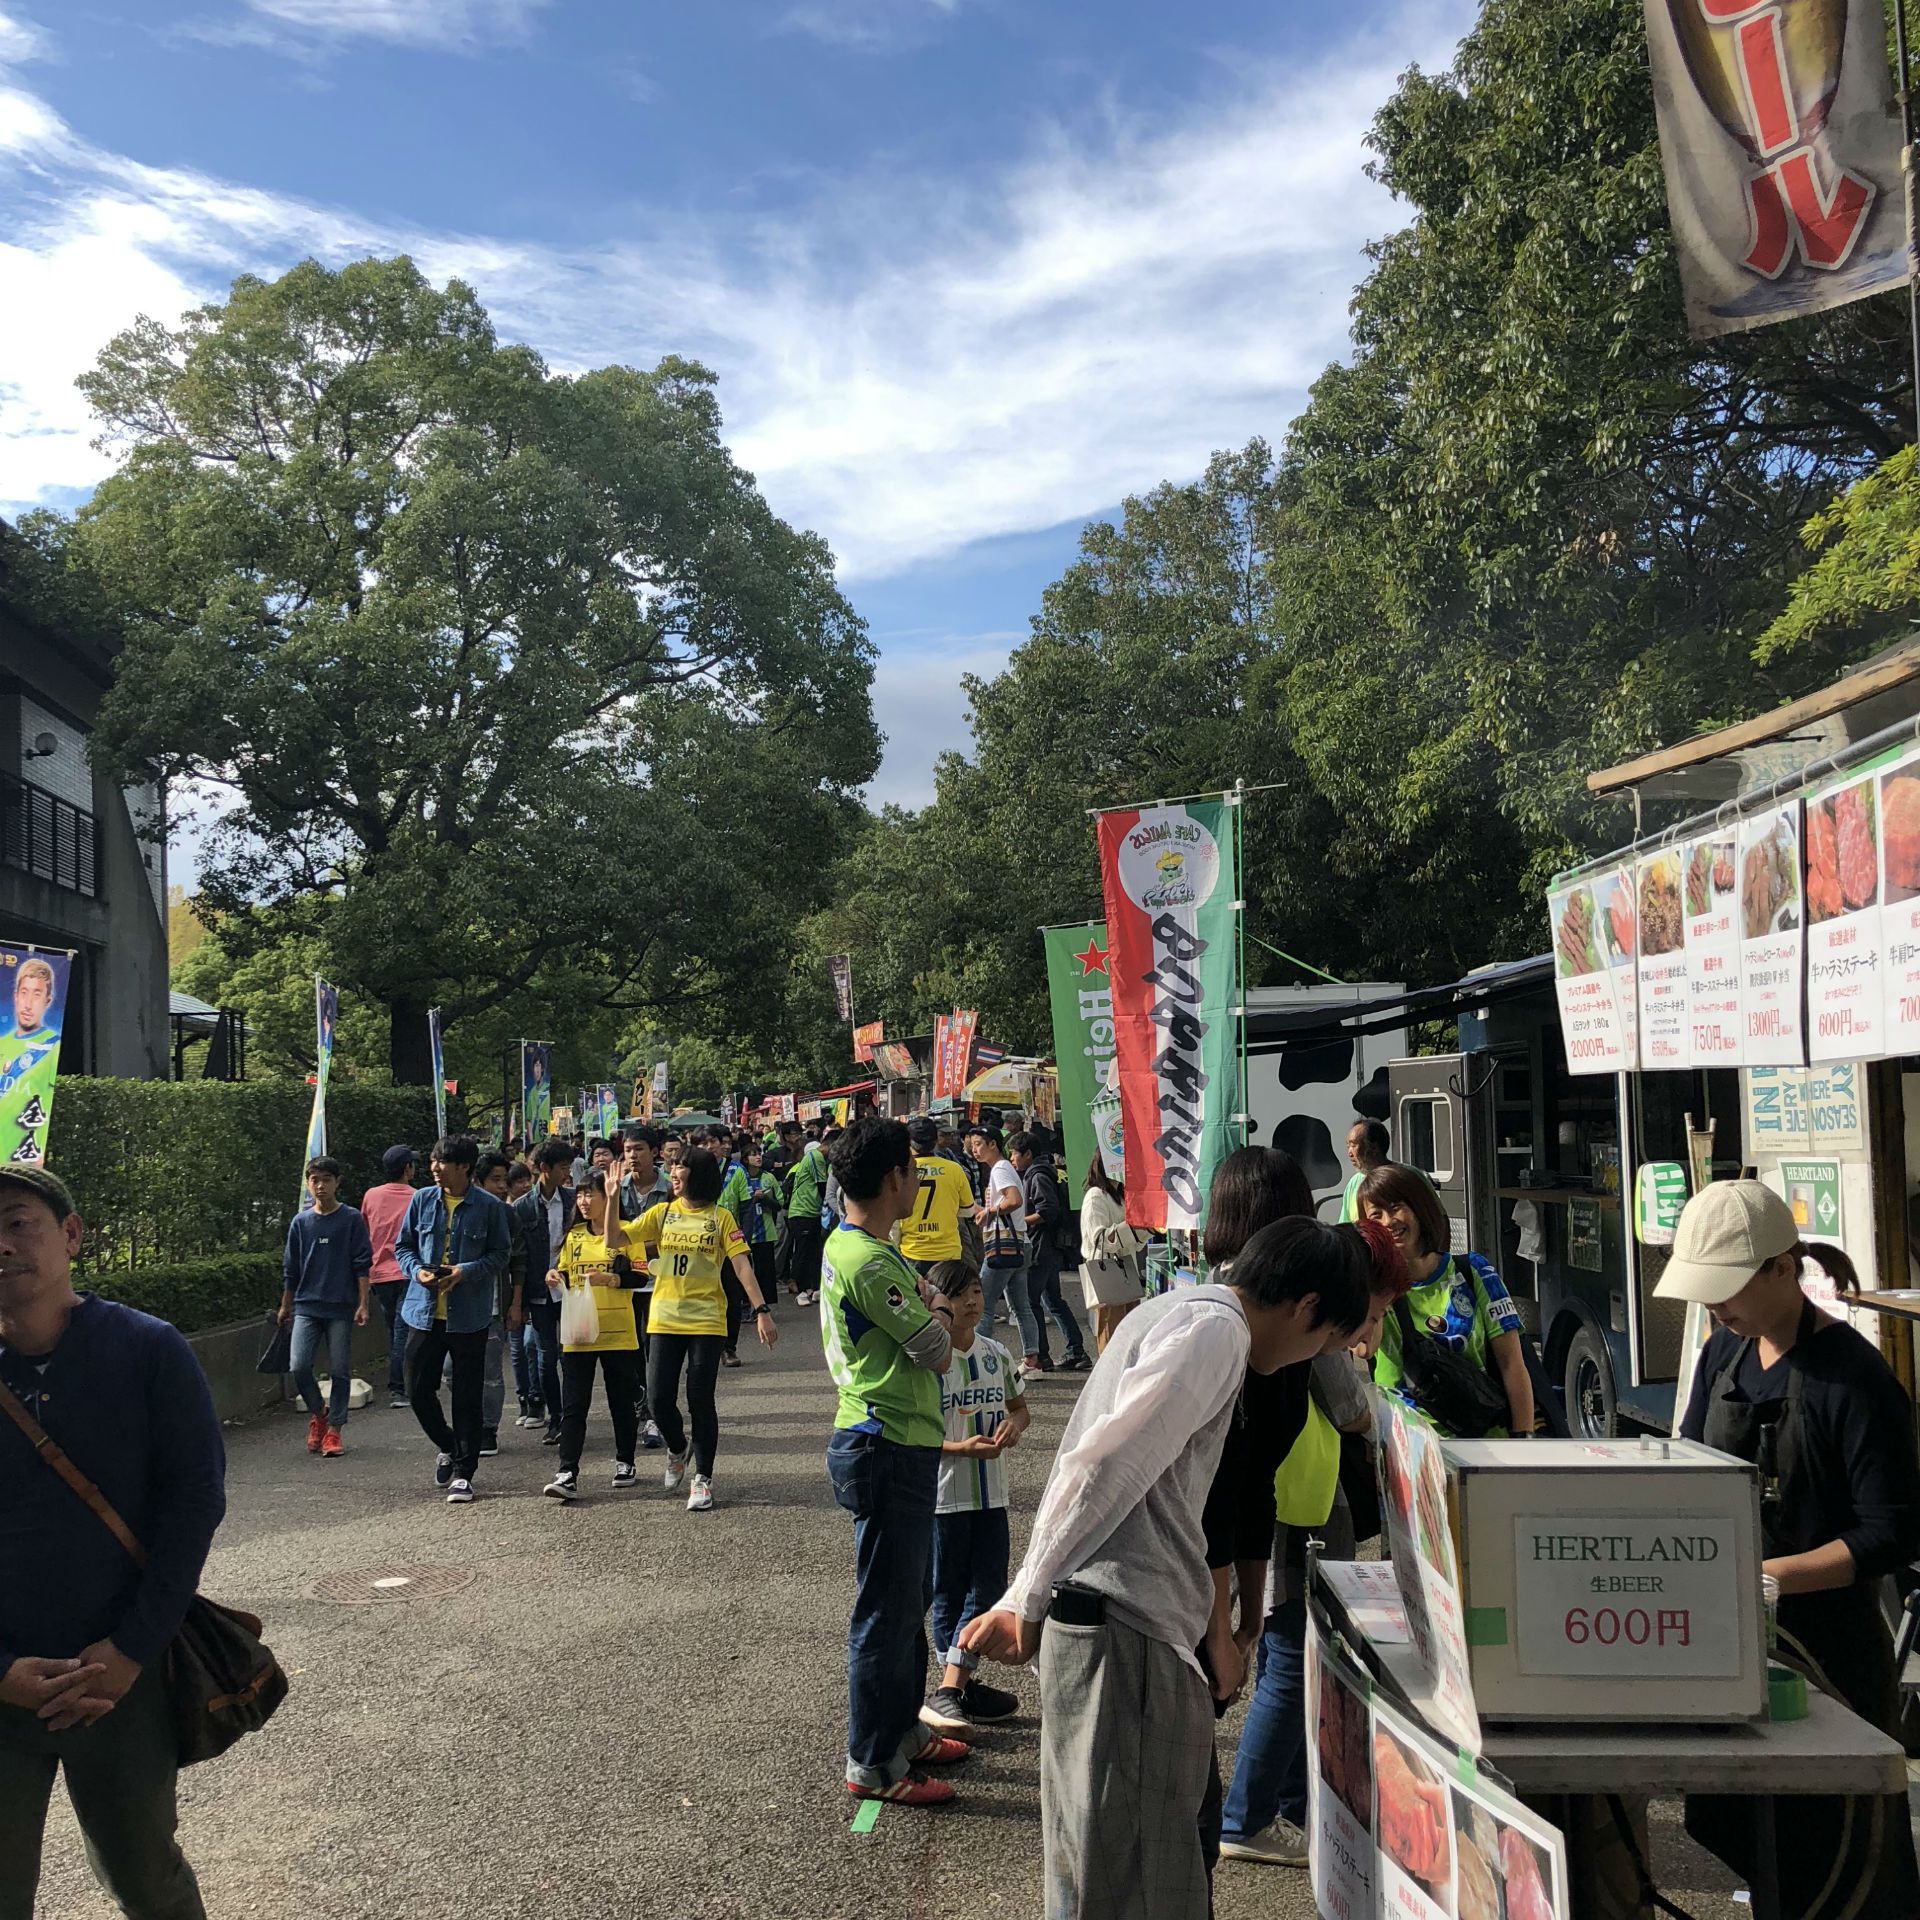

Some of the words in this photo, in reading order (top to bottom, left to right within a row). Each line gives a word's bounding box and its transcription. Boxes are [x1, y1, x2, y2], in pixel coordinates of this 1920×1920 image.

[1811, 949, 1878, 983] 牛ハラミステーキ
[1899, 995, 1920, 1023] 700
[1593, 1017, 1609, 1029] 180g
[1748, 1008, 1780, 1037] 1300円
[1818, 1008, 1851, 1037] 600円
[1570, 1037, 1605, 1058] 2000円
[1692, 1025, 1721, 1050] 750円
[1786, 1166, 1835, 1181] HEARTLAND
[920, 1179, 936, 1220] 7
[918, 1222, 940, 1233] OTANI
[673, 1253, 689, 1276] 18
[1532, 1535, 1719, 1562] HERTLAND
[1590, 1576, 1664, 1593] 生BEER
[1564, 1608, 1691, 1647] 600円
